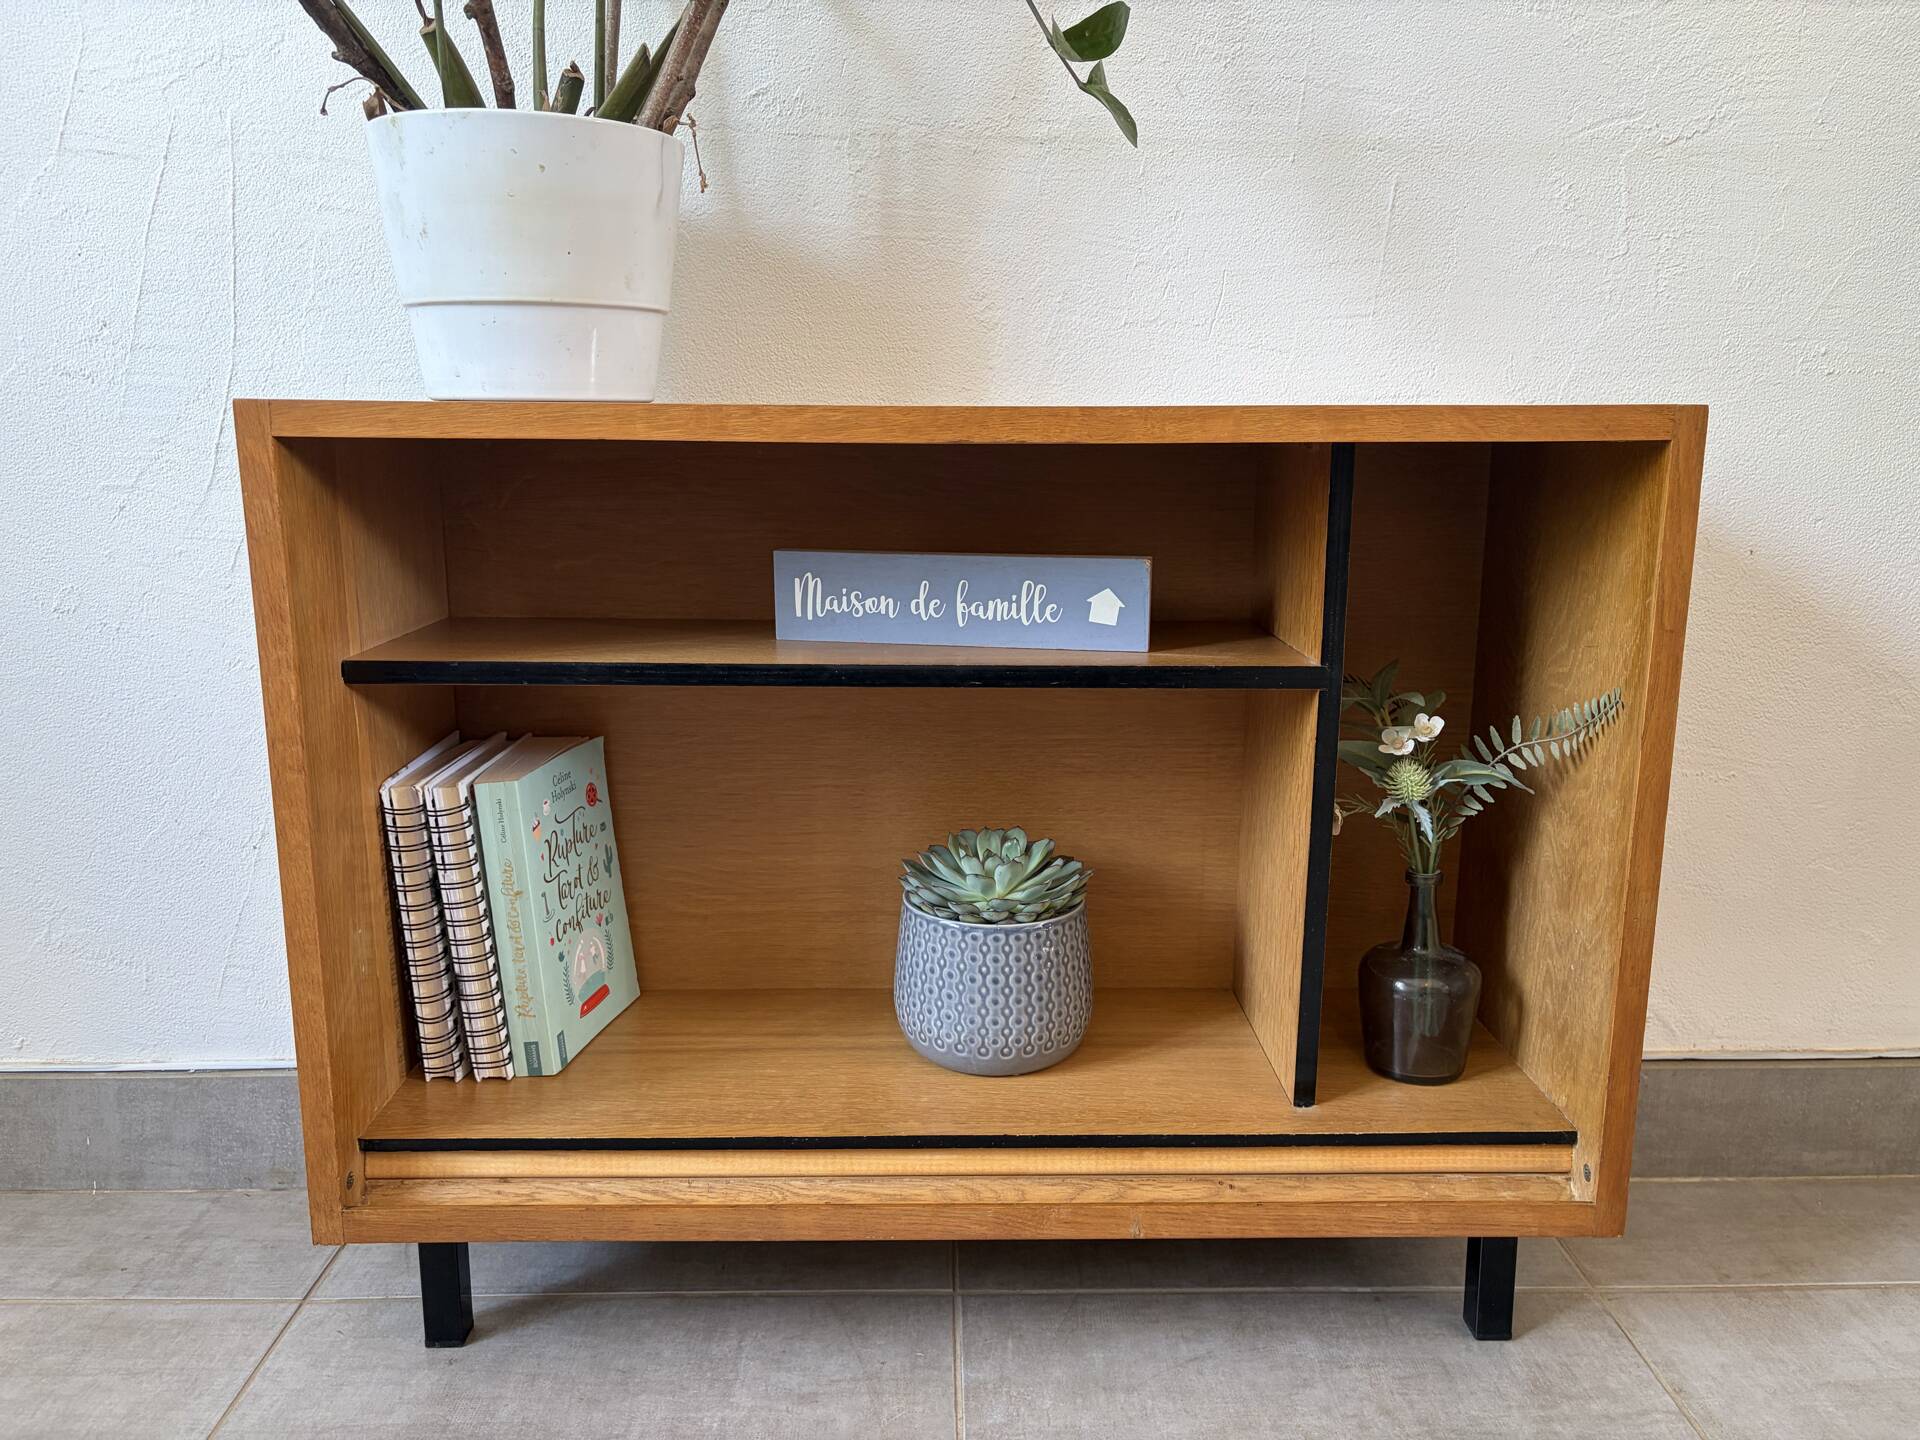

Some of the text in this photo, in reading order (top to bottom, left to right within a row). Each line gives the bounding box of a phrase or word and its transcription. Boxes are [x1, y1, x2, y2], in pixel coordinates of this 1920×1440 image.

[794, 571, 1063, 627] Maison de famille
[544, 806, 598, 876] Rupture
[543, 855, 600, 910] Tarot &
